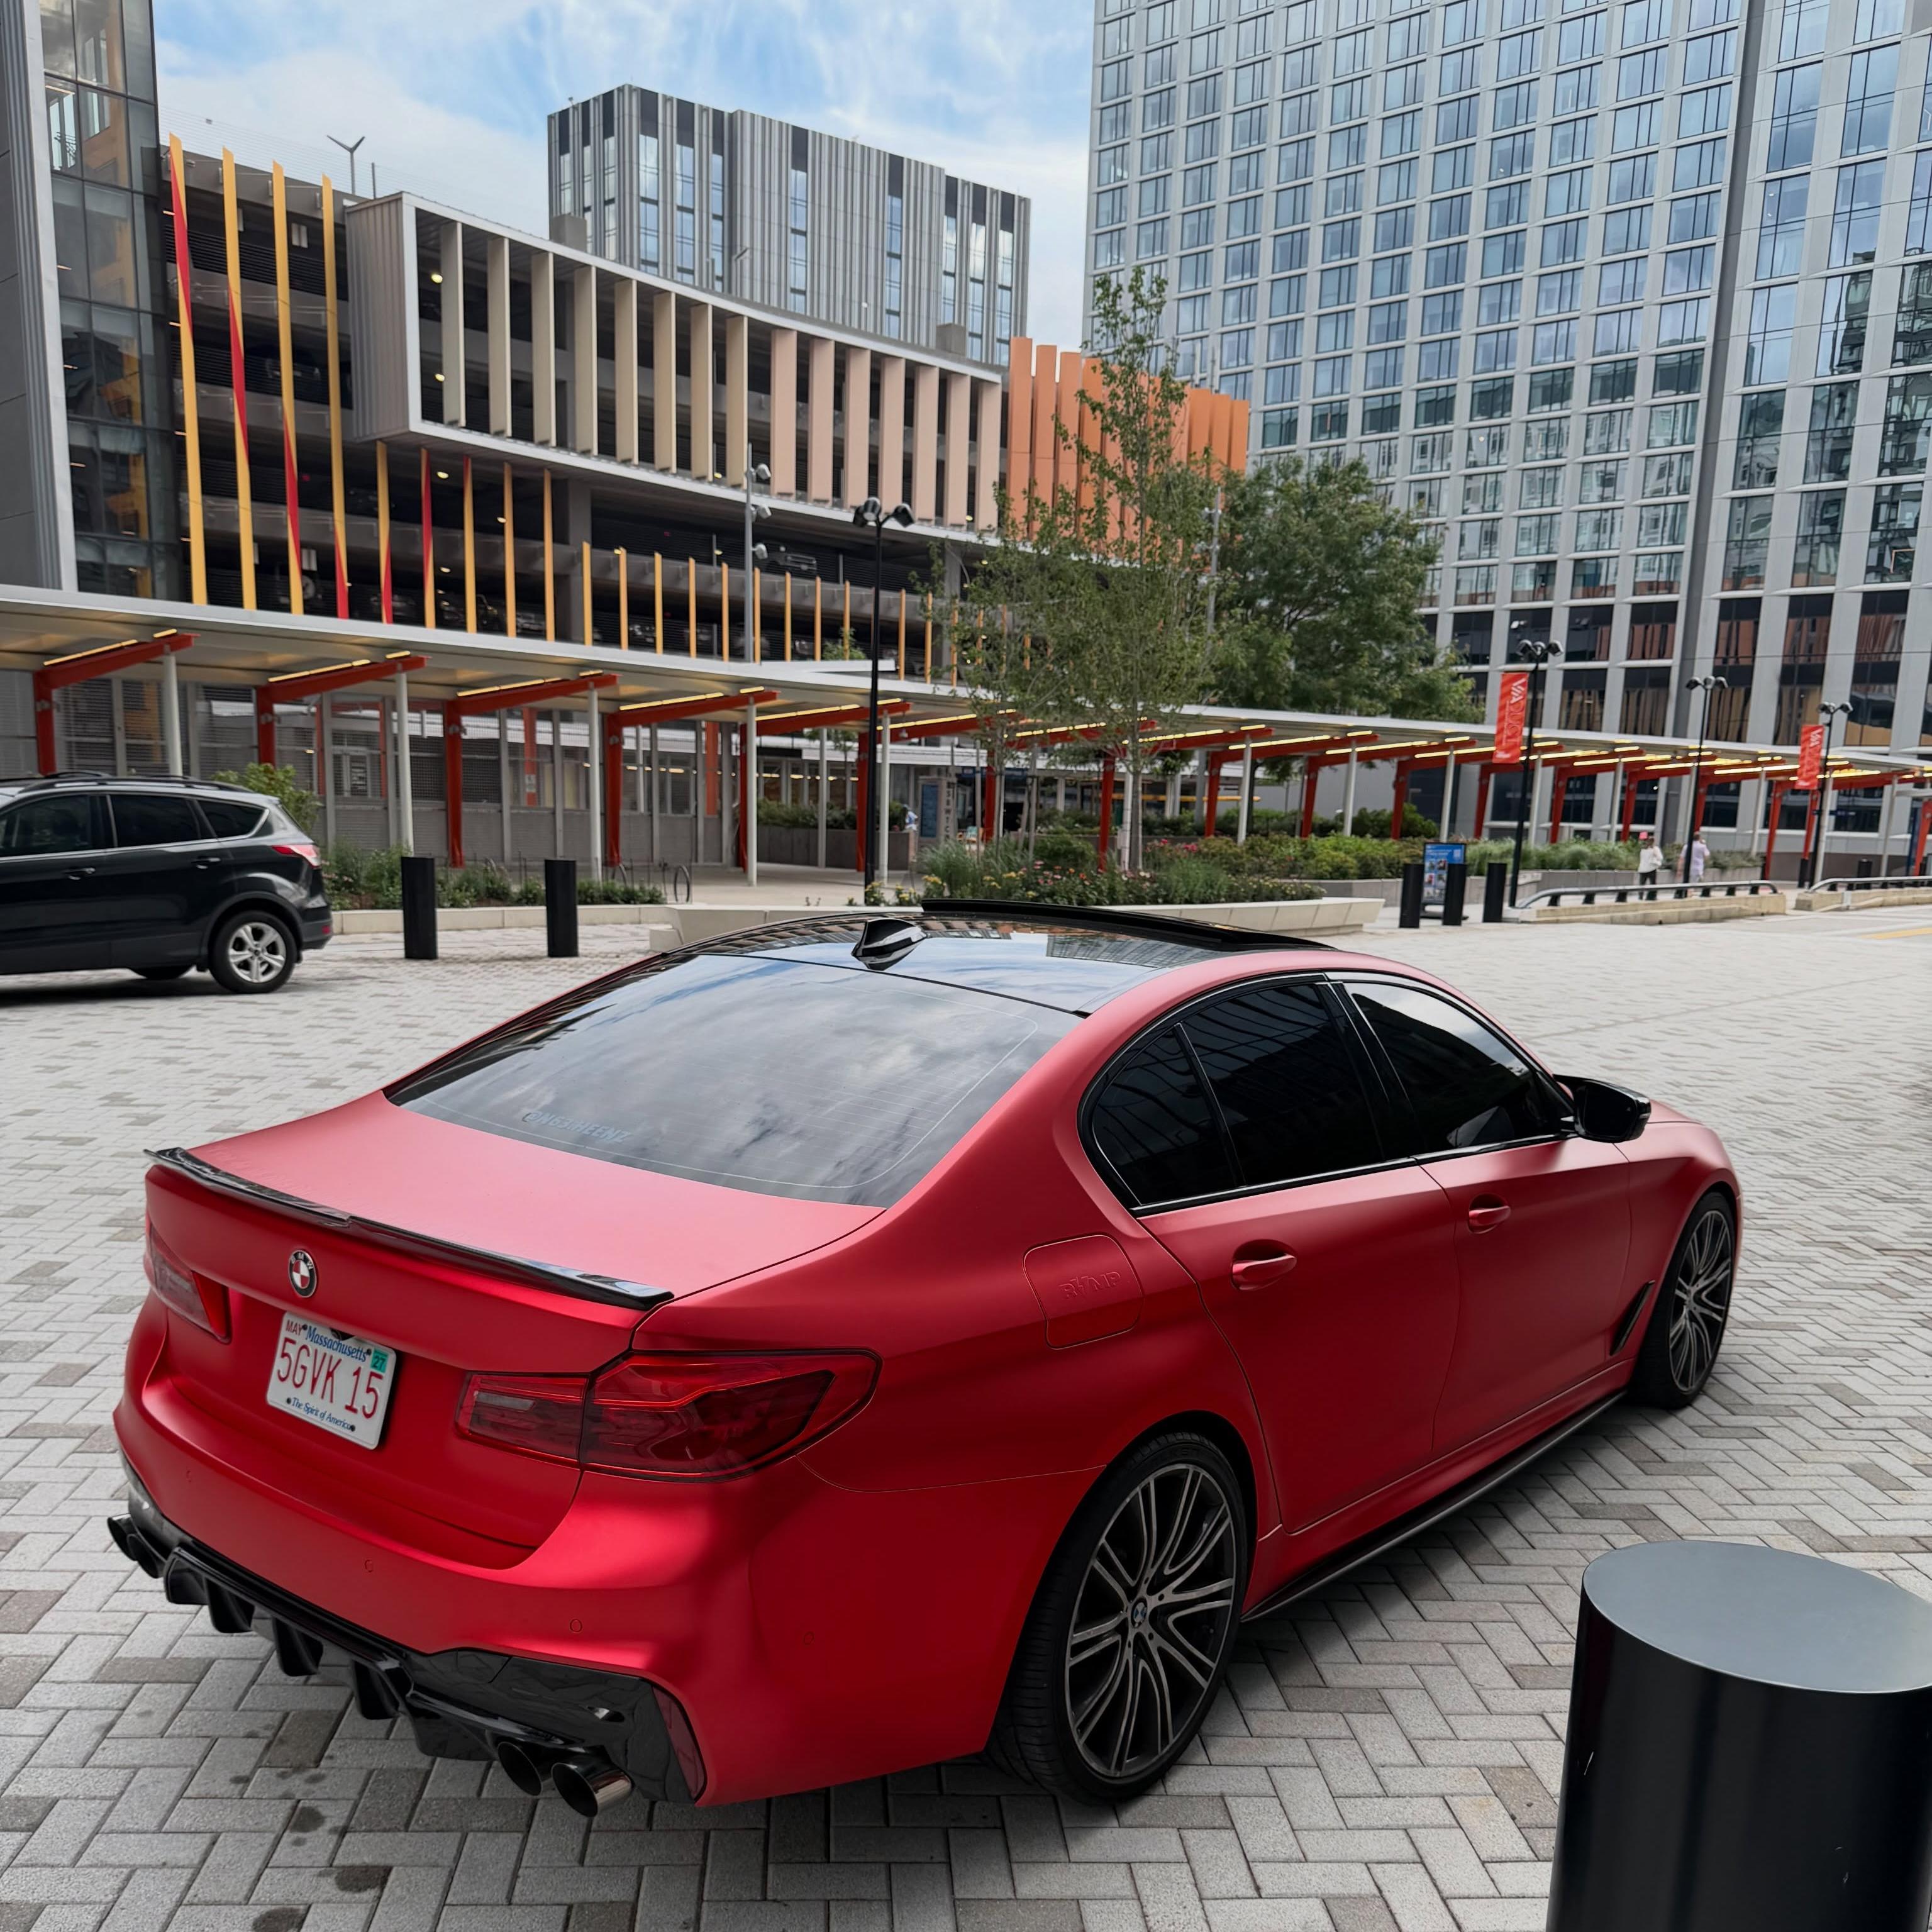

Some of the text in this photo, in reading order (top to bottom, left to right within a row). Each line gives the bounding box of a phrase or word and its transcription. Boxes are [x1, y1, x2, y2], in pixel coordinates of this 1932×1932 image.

[286, 1319, 303, 1336] MAY
[305, 1326, 367, 1362] Massachusetts
[277, 1337, 383, 1419] 5GVK 15
[374, 1355, 386, 1370] 27
[292, 1397, 353, 1430] The Spirit of America
